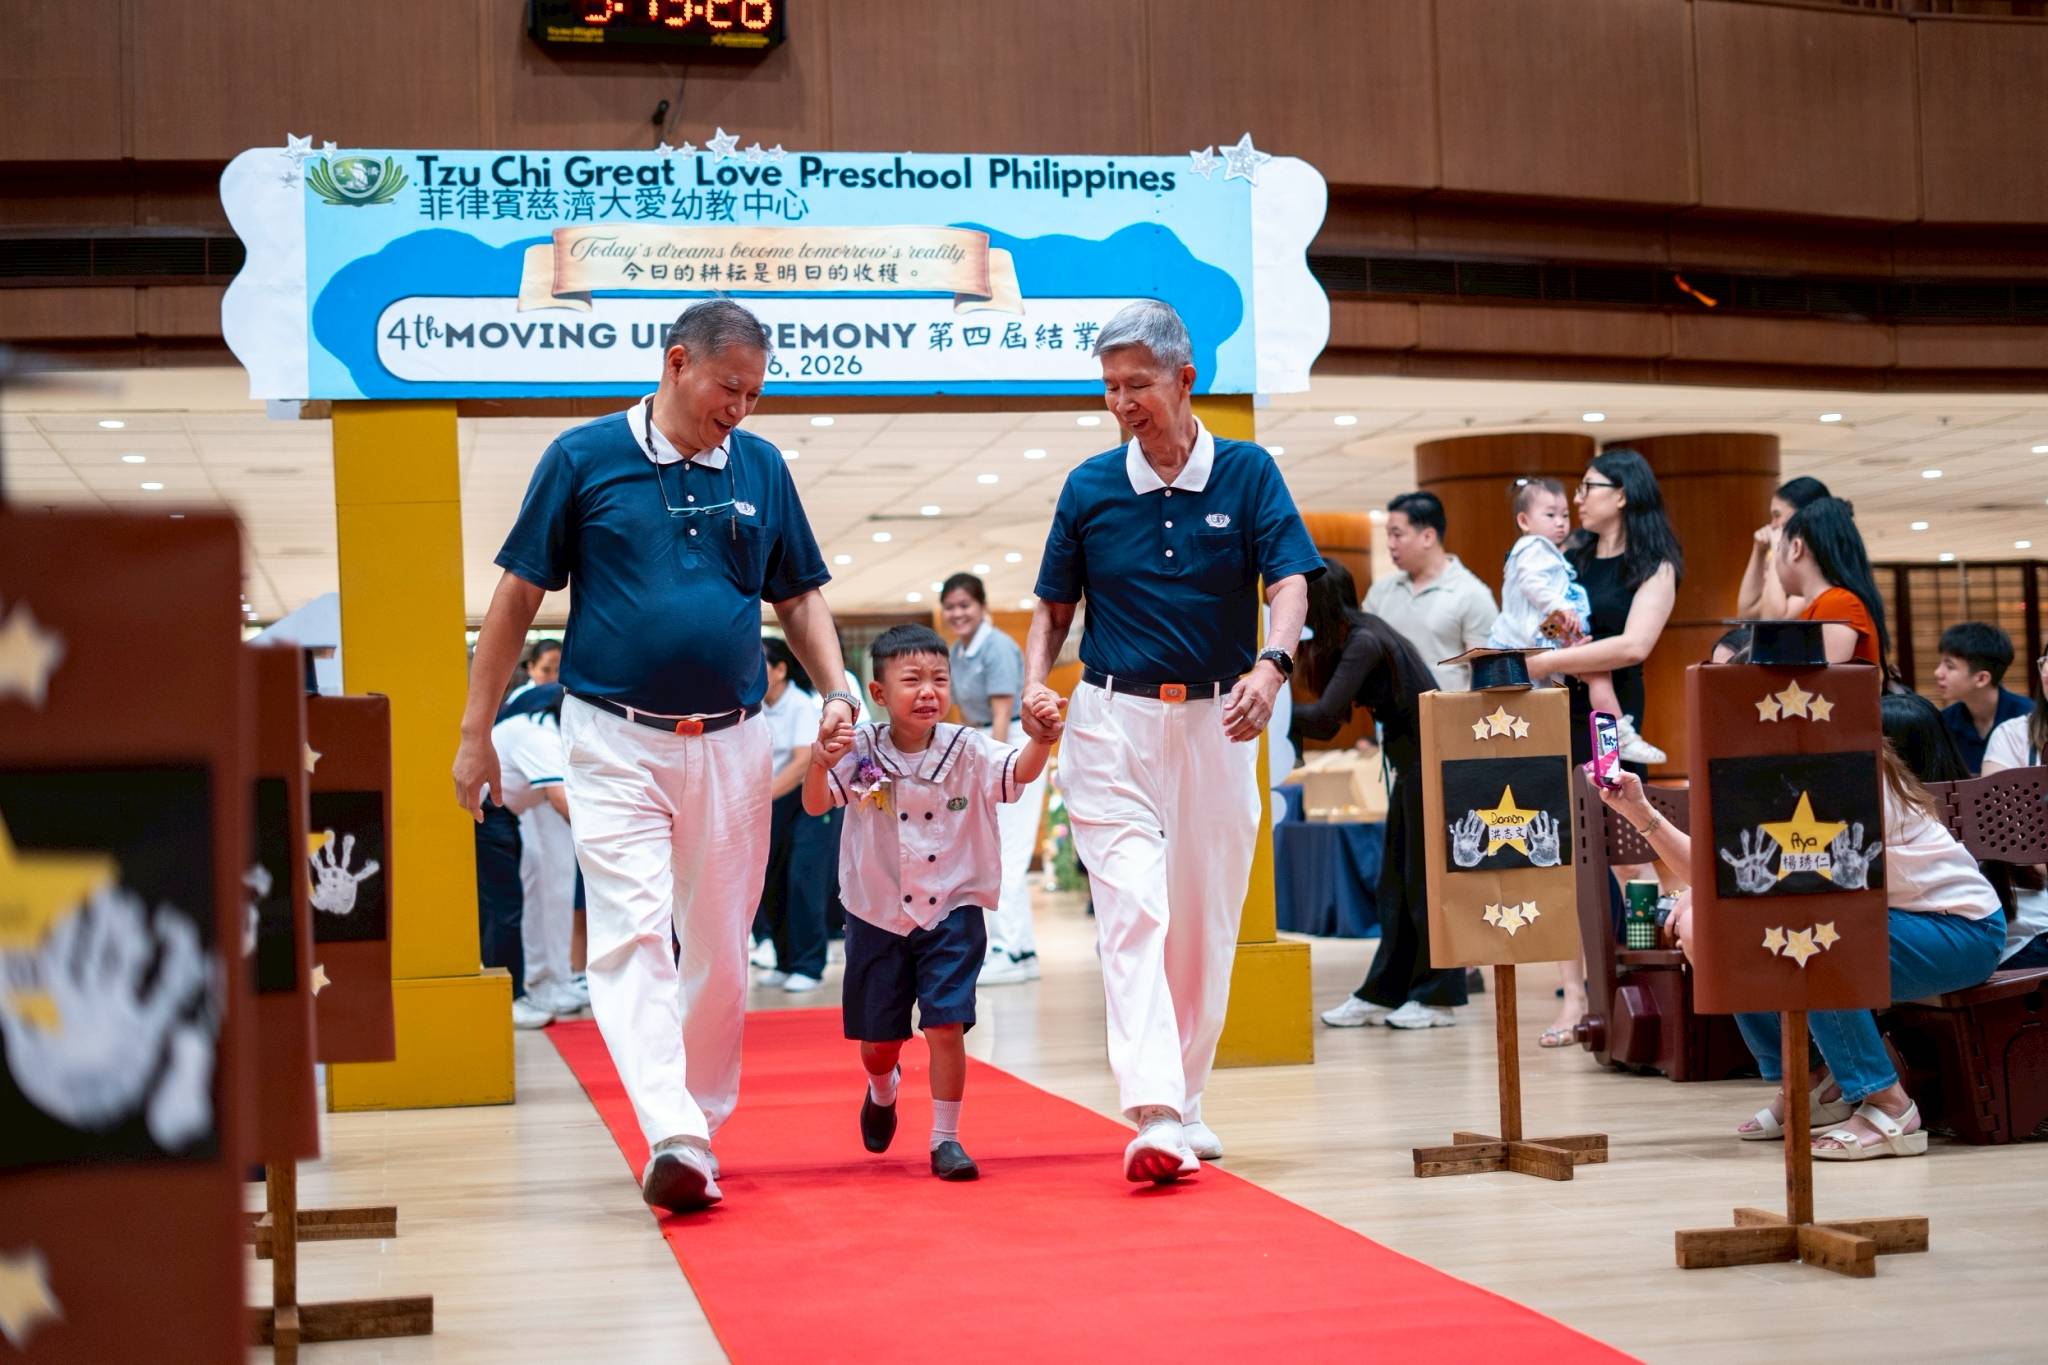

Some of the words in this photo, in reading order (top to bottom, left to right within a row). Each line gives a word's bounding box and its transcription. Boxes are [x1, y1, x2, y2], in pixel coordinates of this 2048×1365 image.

[416, 155, 481, 187] Tzu
[491, 156, 551, 187] Chi
[564, 156, 675, 187] Great
[696, 156, 782, 187] Love
[800, 156, 971, 189] Preschool
[989, 158, 1176, 198] Philippines
[419, 186, 809, 222] 菲律賓慈濟大愛幼教中心
[570, 236, 652, 262] Today's
[657, 240, 726, 259] dreams
[730, 241, 794, 259] become
[798, 242, 901, 260] tomorrow's
[387, 314, 444, 350] 4th
[445, 322, 617, 349] MOVING
[801, 355, 862, 375] 2026
